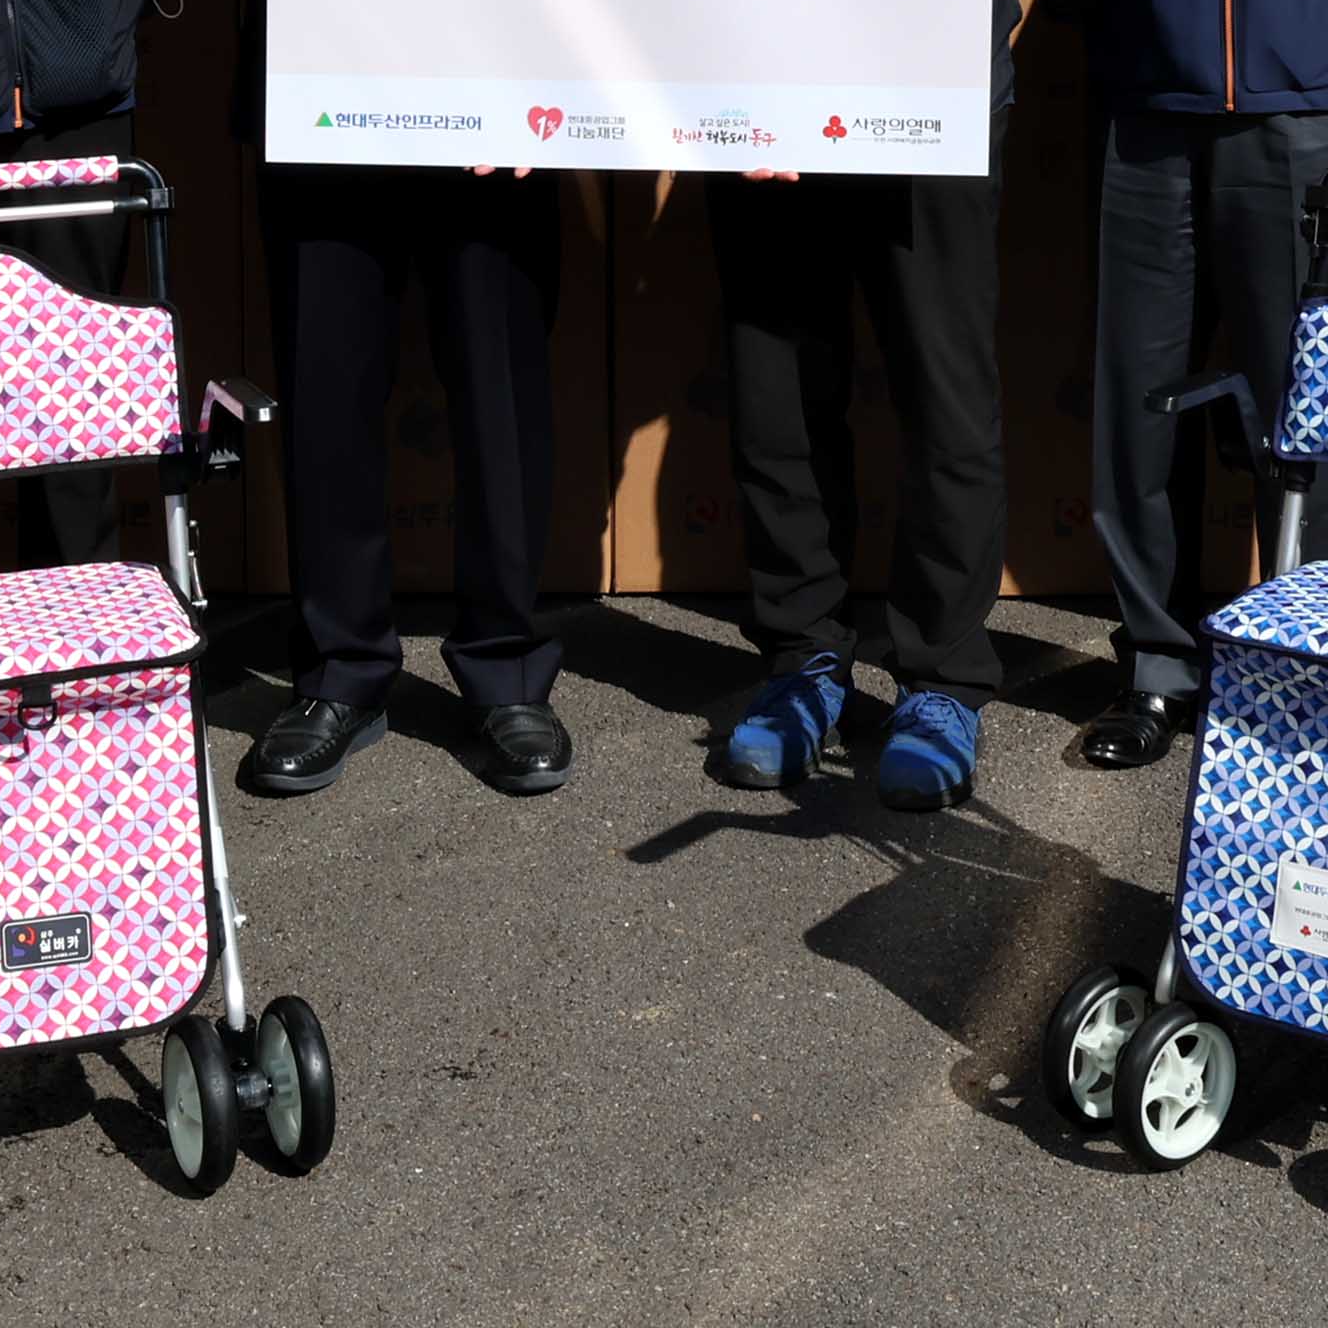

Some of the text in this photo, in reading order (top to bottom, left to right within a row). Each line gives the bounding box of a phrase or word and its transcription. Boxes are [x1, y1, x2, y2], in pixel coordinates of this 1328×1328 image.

[336, 112, 482, 131] 현대두산인프라코어
[852, 118, 941, 136] 사랑의열매
[568, 126, 625, 140] 나눔재단
[749, 128, 777, 147] 동구
[40, 935, 79, 953] 실버카
